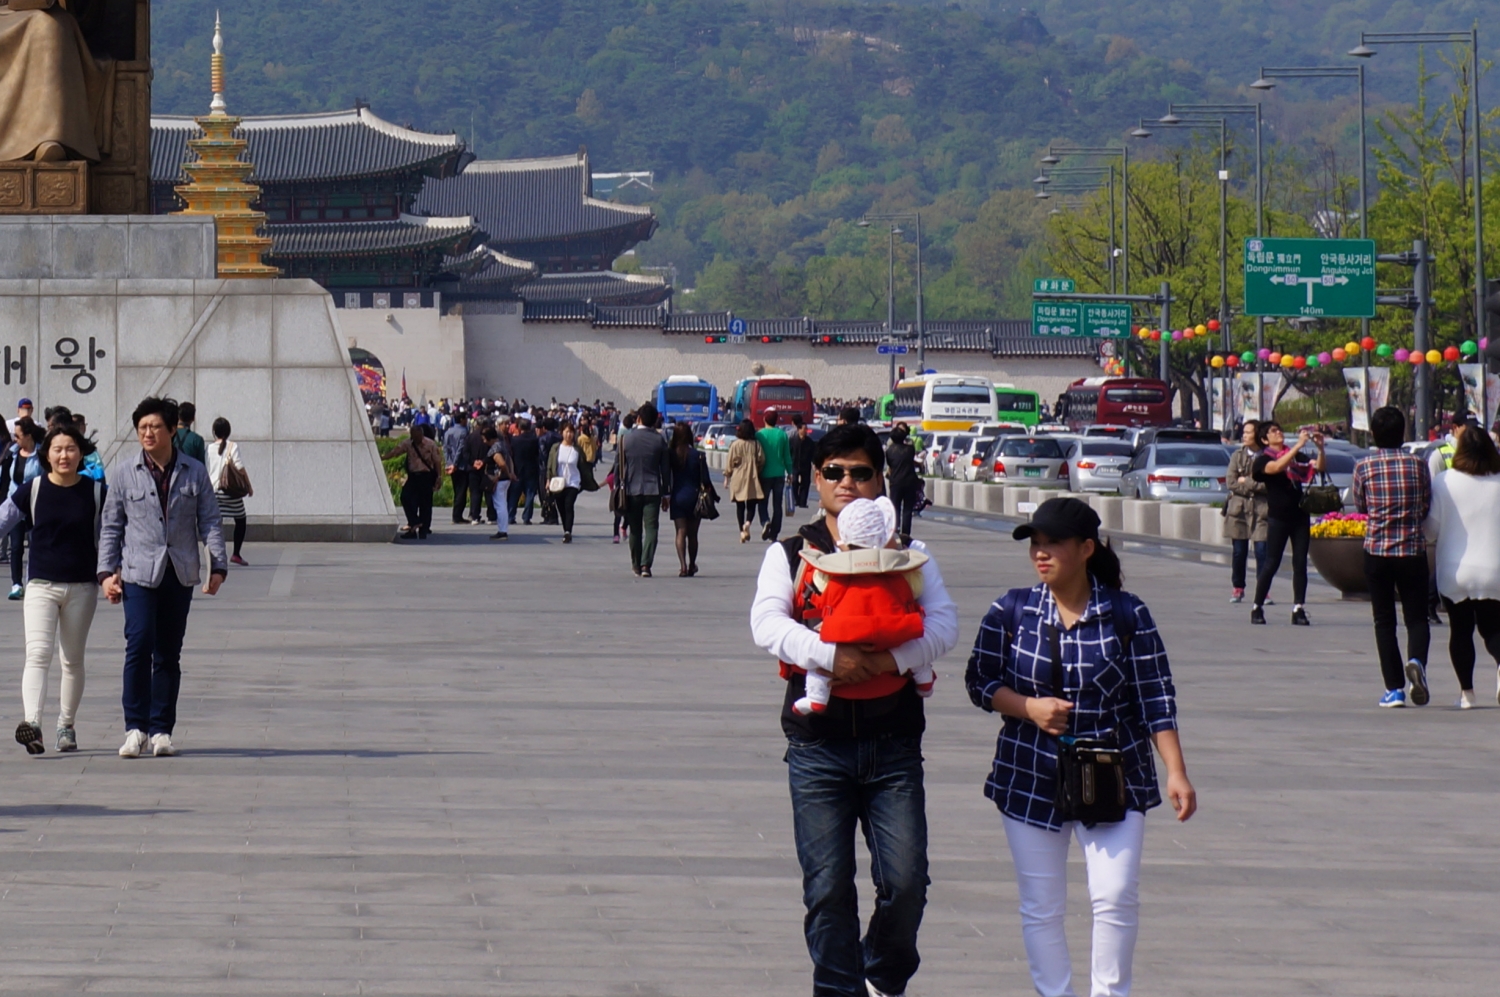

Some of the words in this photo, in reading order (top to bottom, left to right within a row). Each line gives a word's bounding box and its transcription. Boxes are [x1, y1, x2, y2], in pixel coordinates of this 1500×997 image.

[1251, 241, 1261, 250] 21
[1248, 251, 1274, 264] 독립문
[1320, 253, 1371, 265] 안국동사거리
[1246, 264, 1301, 274] Dongnimmun
[1362, 266, 1373, 275] Jct
[1300, 306, 1324, 315] 140m
[1018, 402, 1032, 410] 1711
